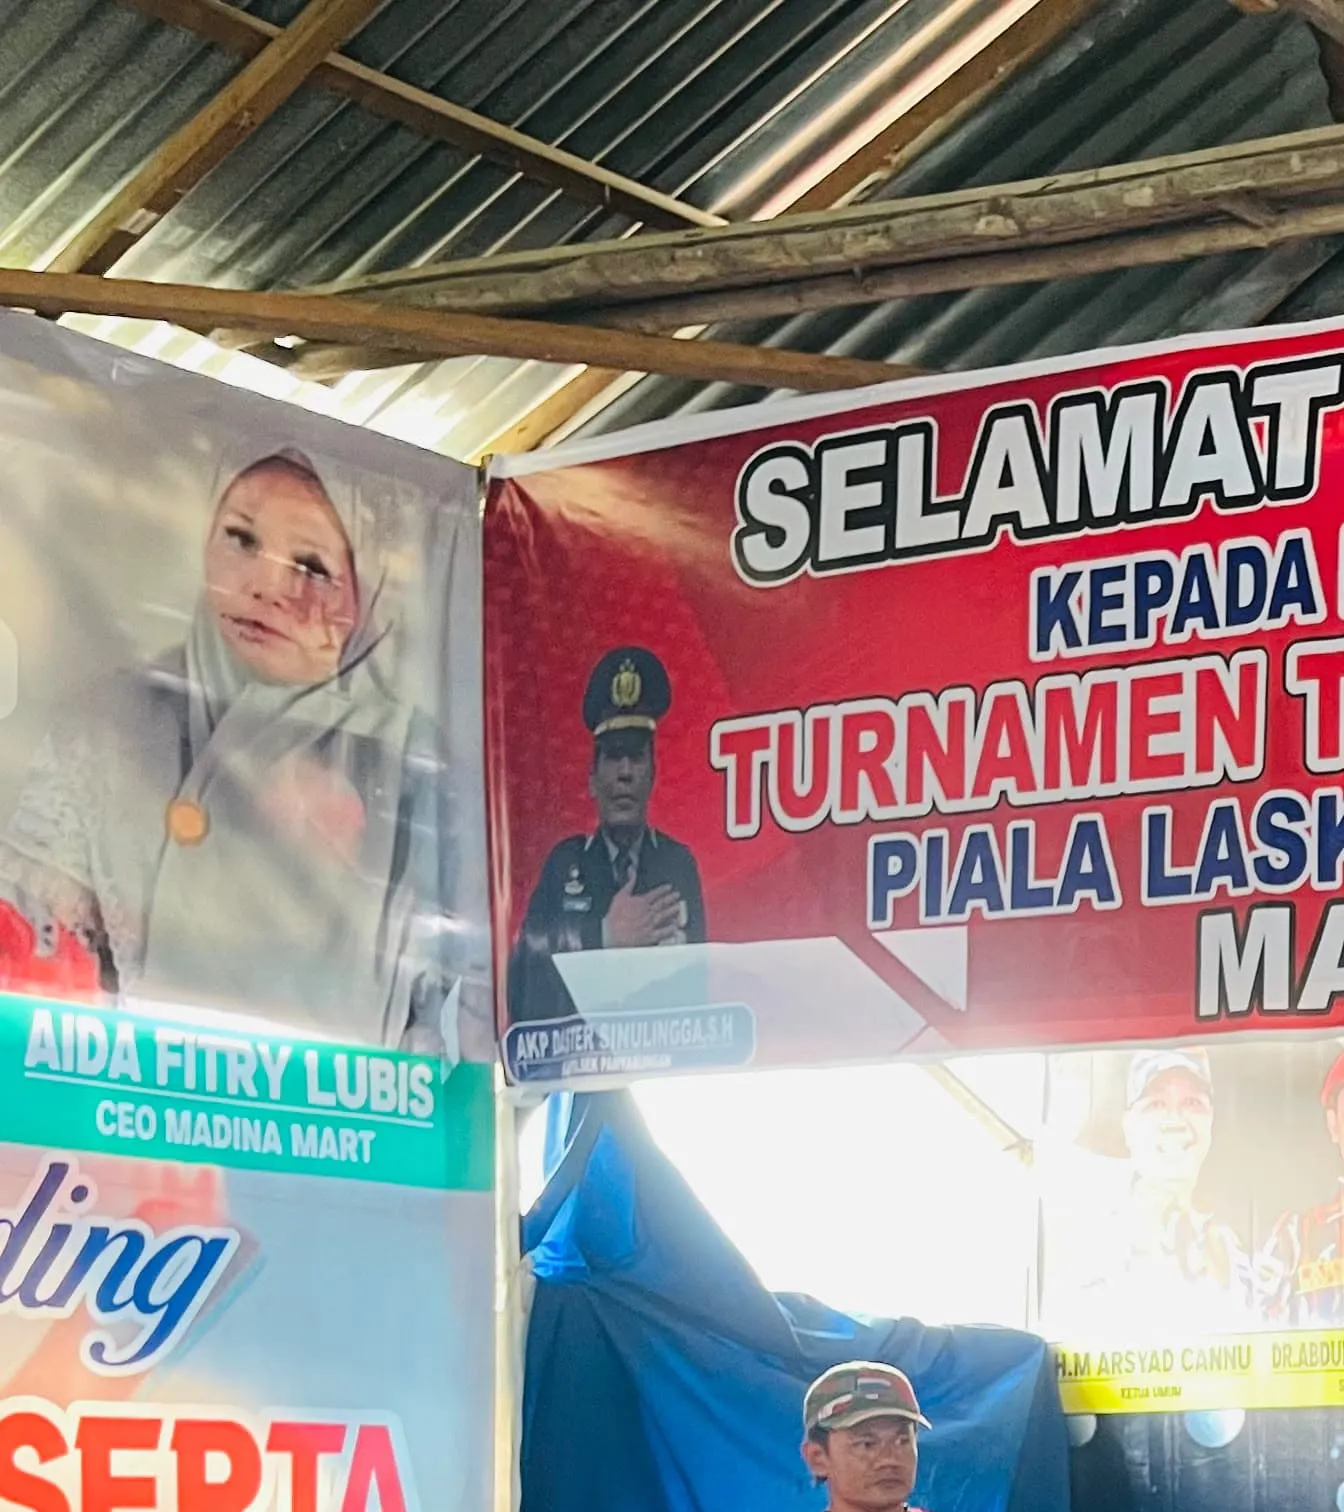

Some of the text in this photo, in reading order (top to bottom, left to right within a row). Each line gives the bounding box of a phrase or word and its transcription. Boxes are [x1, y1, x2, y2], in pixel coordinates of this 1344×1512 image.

[1036, 537, 1316, 656] KEPADA
[716, 655, 1265, 832] TURNAMEN
[871, 818, 1119, 924] PIALA
[25, 1008, 434, 1120] AIDA FITRY LUBIS
[516, 1031, 548, 1062] AKP
[96, 1101, 376, 1163] CEO MADINA MART
[1098, 1348, 1175, 1375] ARSYAD
[1180, 1344, 1252, 1373] CANNU
